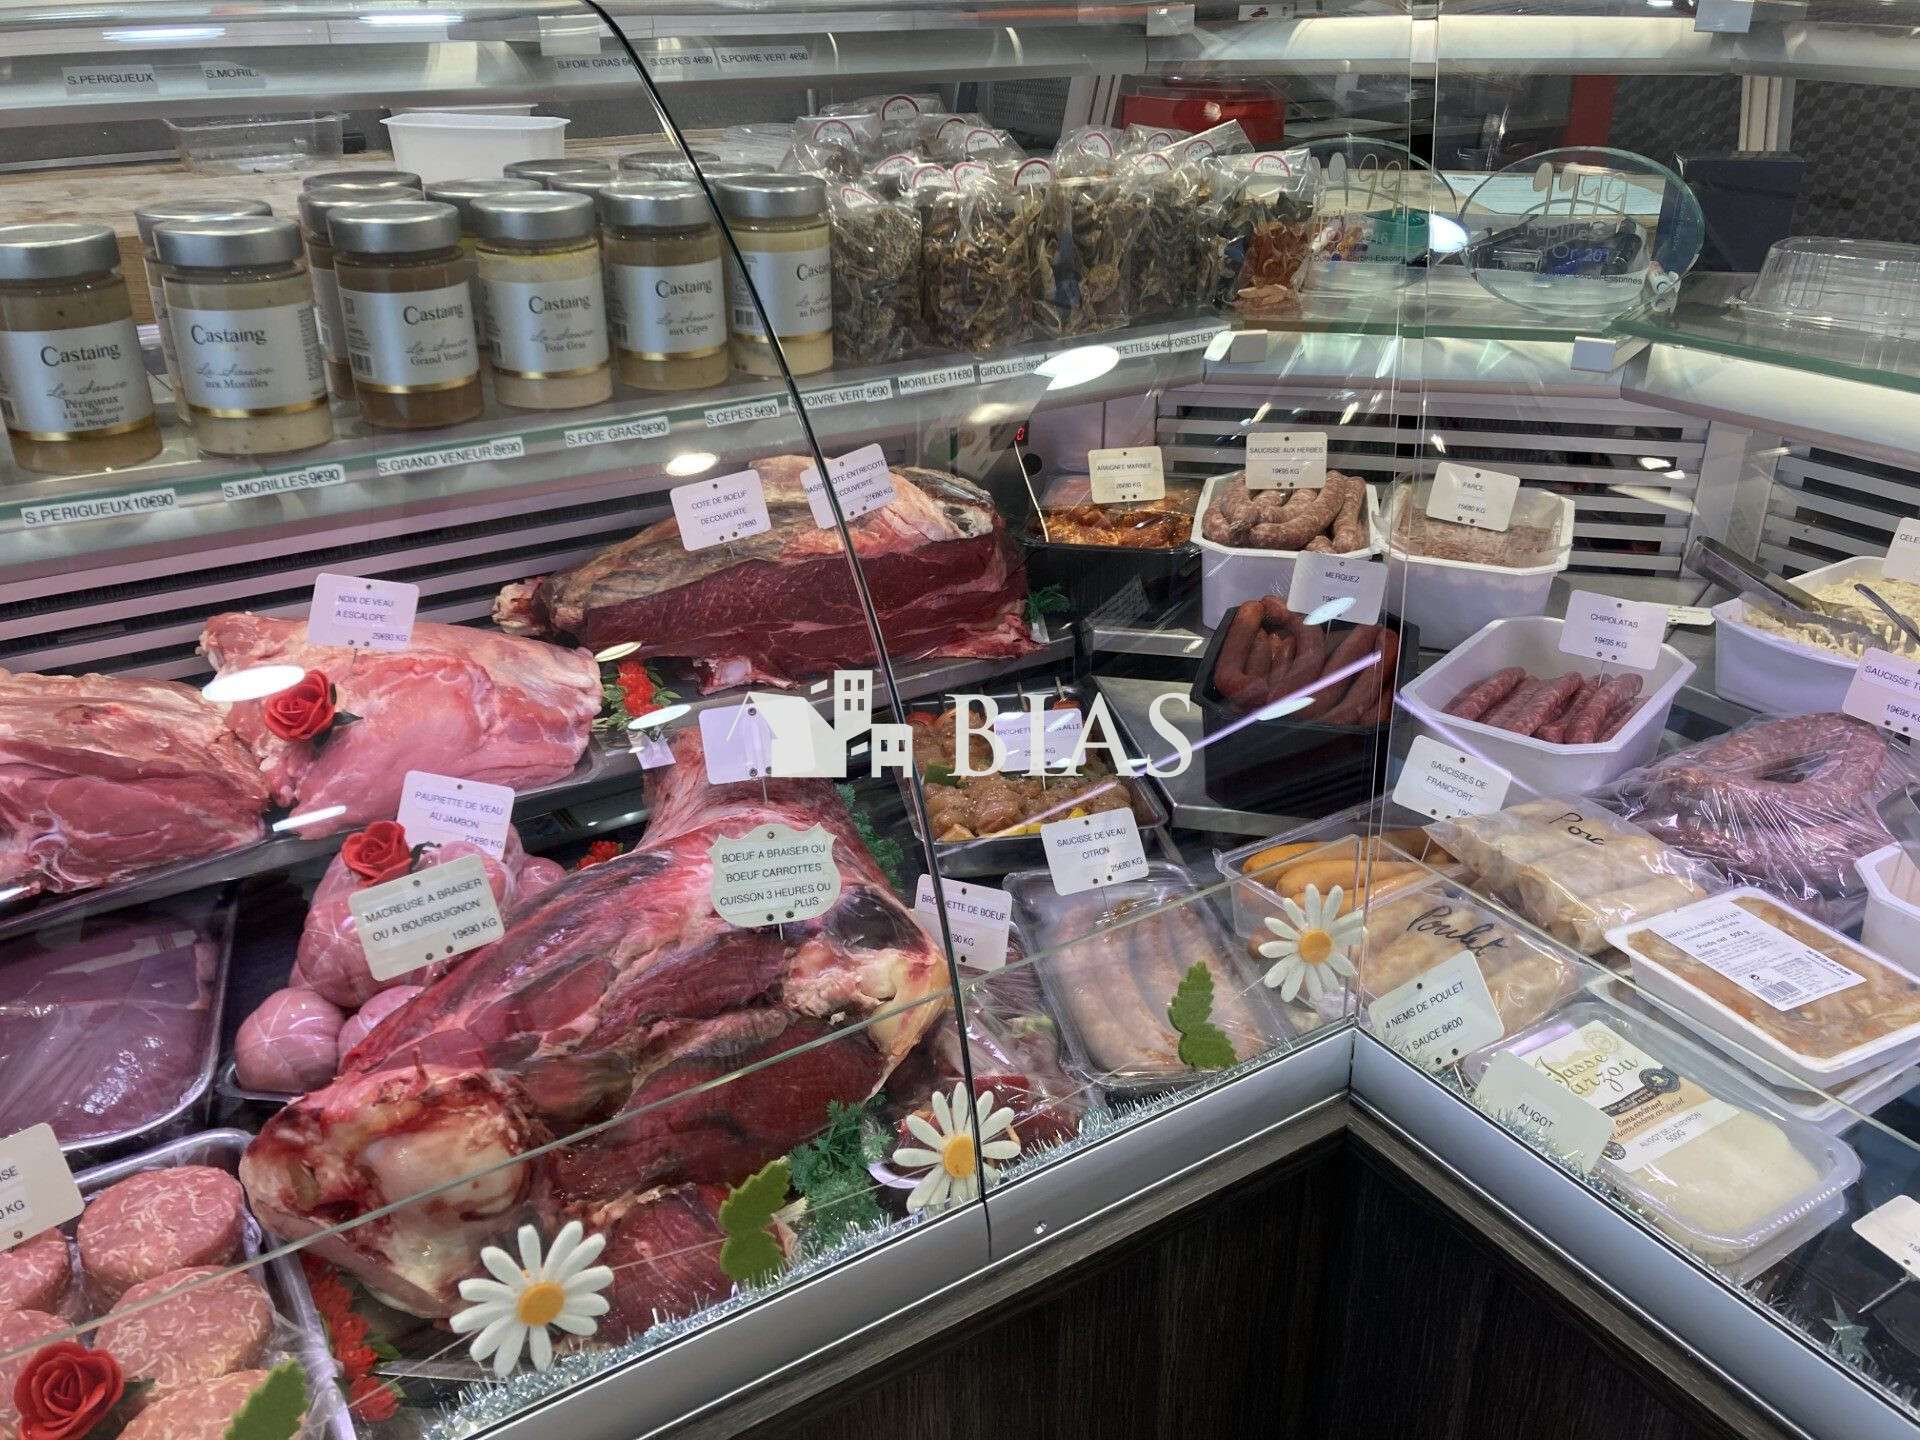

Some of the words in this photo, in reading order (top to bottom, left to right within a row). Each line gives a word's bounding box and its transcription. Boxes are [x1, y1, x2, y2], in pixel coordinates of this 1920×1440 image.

[66, 70, 154, 87] S.PERIGUEUX
[655, 277, 713, 300] Castaing
[403, 302, 465, 327] Castaing
[529, 295, 592, 315] Castaing
[190, 323, 268, 347] Castaing
[40, 342, 121, 367] Castaing
[409, 352, 443, 367] Grand
[980, 361, 1024, 378] GIROLLES
[223, 377, 271, 391] Morilles
[900, 372, 947, 390] MORILLES
[838, 389, 866, 401] VERT
[607, 424, 643, 440] GRAS
[377, 456, 436, 475] S.GRAND
[438, 447, 492, 465] VENEUR
[224, 473, 309, 499] S.MORILLES
[308, 468, 341, 485] 9€90
[722, 489, 749, 503] BOEUF
[24, 501, 134, 526] S.PERIGUEUX
[133, 493, 176, 512] 10€90
[700, 507, 748, 526] DECOUVERTE
[1324, 570, 1361, 585] MERGUEZ
[372, 598, 395, 608] VEAU
[1590, 612, 1640, 629] CHIPOLATAS
[1615, 640, 1628, 649] KG
[1864, 664, 1911, 687] SAUCISSE
[1430, 759, 1475, 787] SAUCISSES
[1475, 779, 1489, 790] DE
[1426, 775, 1474, 802] FRANCFORT
[414, 790, 463, 807] PAUPIETTE
[464, 800, 478, 810] DE
[480, 803, 504, 816] VEAU
[430, 810, 441, 821] AU
[1056, 833, 1093, 848] SAUCISSE
[1093, 831, 1106, 841] DE
[1106, 827, 1127, 839] VEAU
[721, 850, 756, 864] BOEUF
[757, 850, 766, 860] A
[766, 845, 810, 859] BRAISER
[810, 843, 826, 855] OU
[1081, 846, 1111, 860] CITRON
[1131, 856, 1144, 866] KG
[725, 870, 761, 883] BOEUF
[761, 862, 823, 879] CARROTTES
[364, 896, 425, 924] MACREUSE
[426, 893, 437, 904] A
[436, 877, 483, 901] BRAISER
[719, 892, 765, 907] CUISSON
[766, 890, 773, 900] 3
[774, 884, 815, 899] HEURES
[816, 881, 832, 892] OU
[794, 896, 820, 909] PLUS
[921, 893, 968, 913] BROETTE
[967, 904, 979, 915] DE
[979, 907, 1008, 921] BOEUF
[372, 928, 390, 942] OU
[391, 925, 401, 936] A
[401, 898, 481, 932] BOURGUIGNON
[481, 917, 498, 930] KG
[962, 936, 975, 947] KG
[1384, 1020, 1391, 1030] 4
[1390, 1006, 1417, 1029] NEMS
[1416, 1000, 1429, 1014] DE
[1429, 981, 1465, 1006] POULET
[1411, 1026, 1442, 1050] SAUCE
[1441, 1016, 1464, 1034] 8€00
[1516, 1102, 1555, 1129] ALIGOT
[5, 1199, 26, 1214] KG
